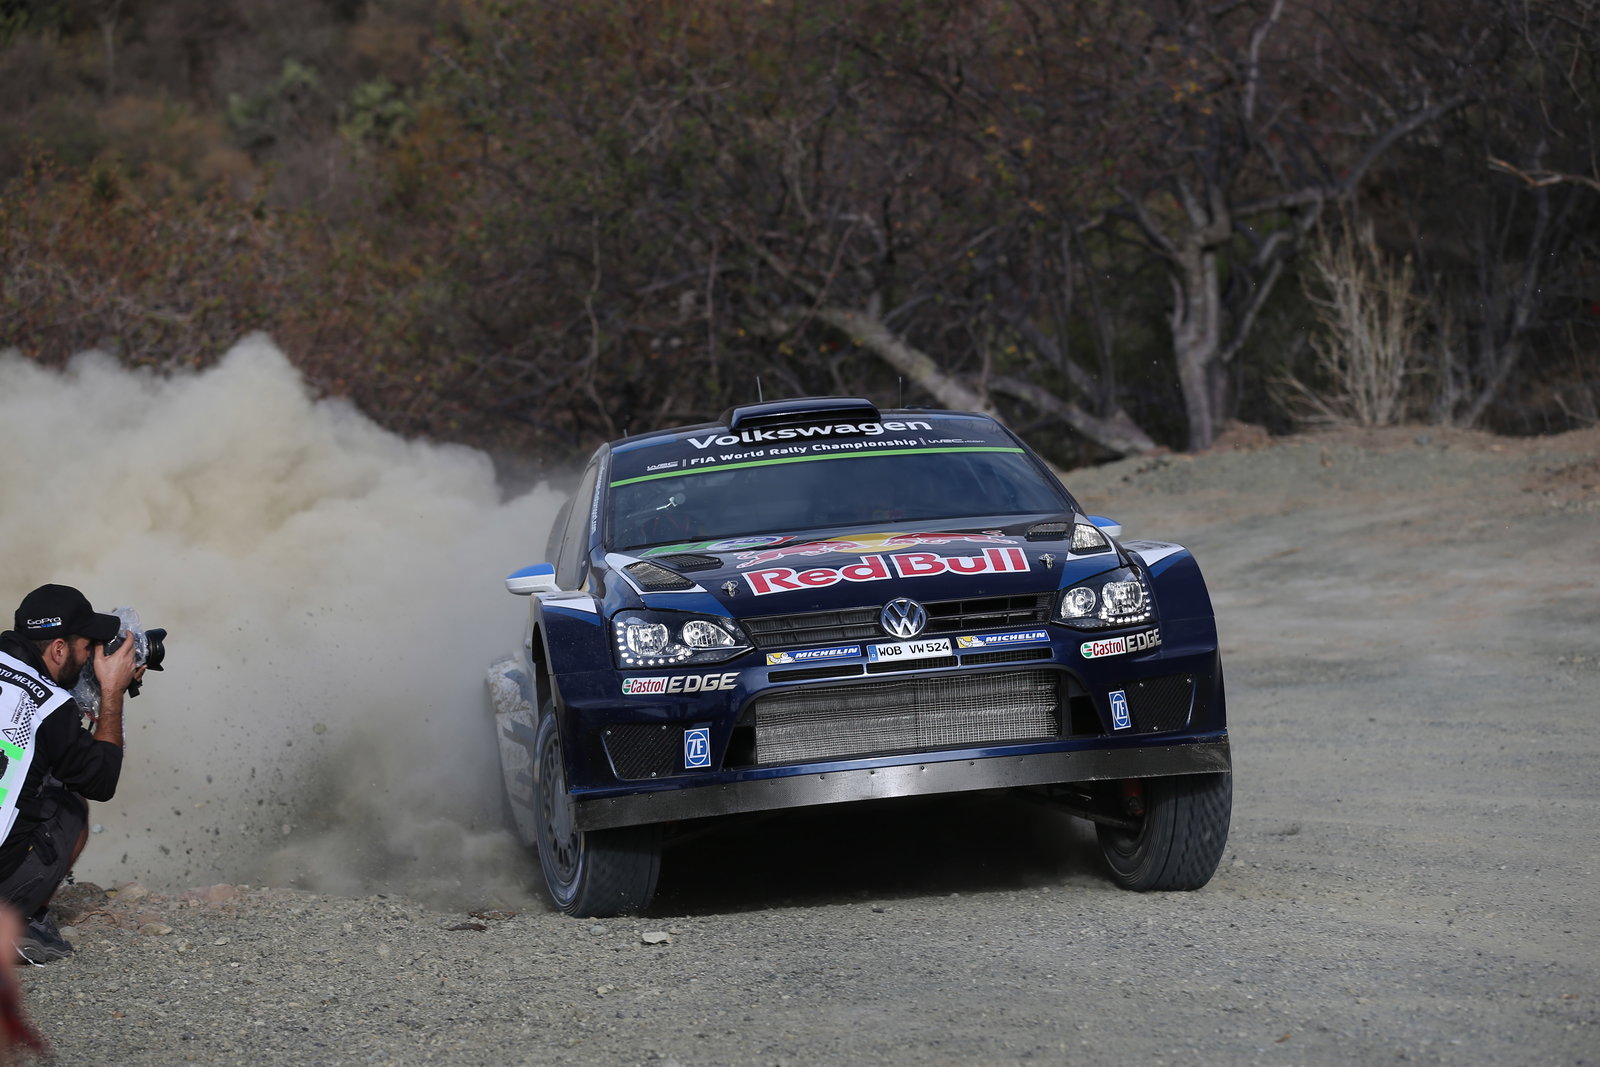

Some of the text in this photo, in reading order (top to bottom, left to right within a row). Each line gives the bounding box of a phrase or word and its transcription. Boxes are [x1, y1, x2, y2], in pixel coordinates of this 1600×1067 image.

[688, 420, 932, 450] Volkswagen
[690, 456, 716, 465] FIA
[720, 450, 765, 461] World
[769, 445, 807, 456] Rally
[812, 438, 918, 452] Championship
[744, 547, 1029, 594] Red Bull
[27, 616, 62, 625] GoPro
[985, 630, 1047, 643] MICHELIN
[1093, 628, 1162, 657] Castrol EDGE
[794, 647, 858, 660] MICHELIN
[878, 642, 949, 657] WOB VW 524
[12, 673, 46, 698] MEXICO
[630, 672, 741, 695] Castrol EDGE
[1112, 699, 1128, 721] ZF
[687, 736, 706, 760] ZF
